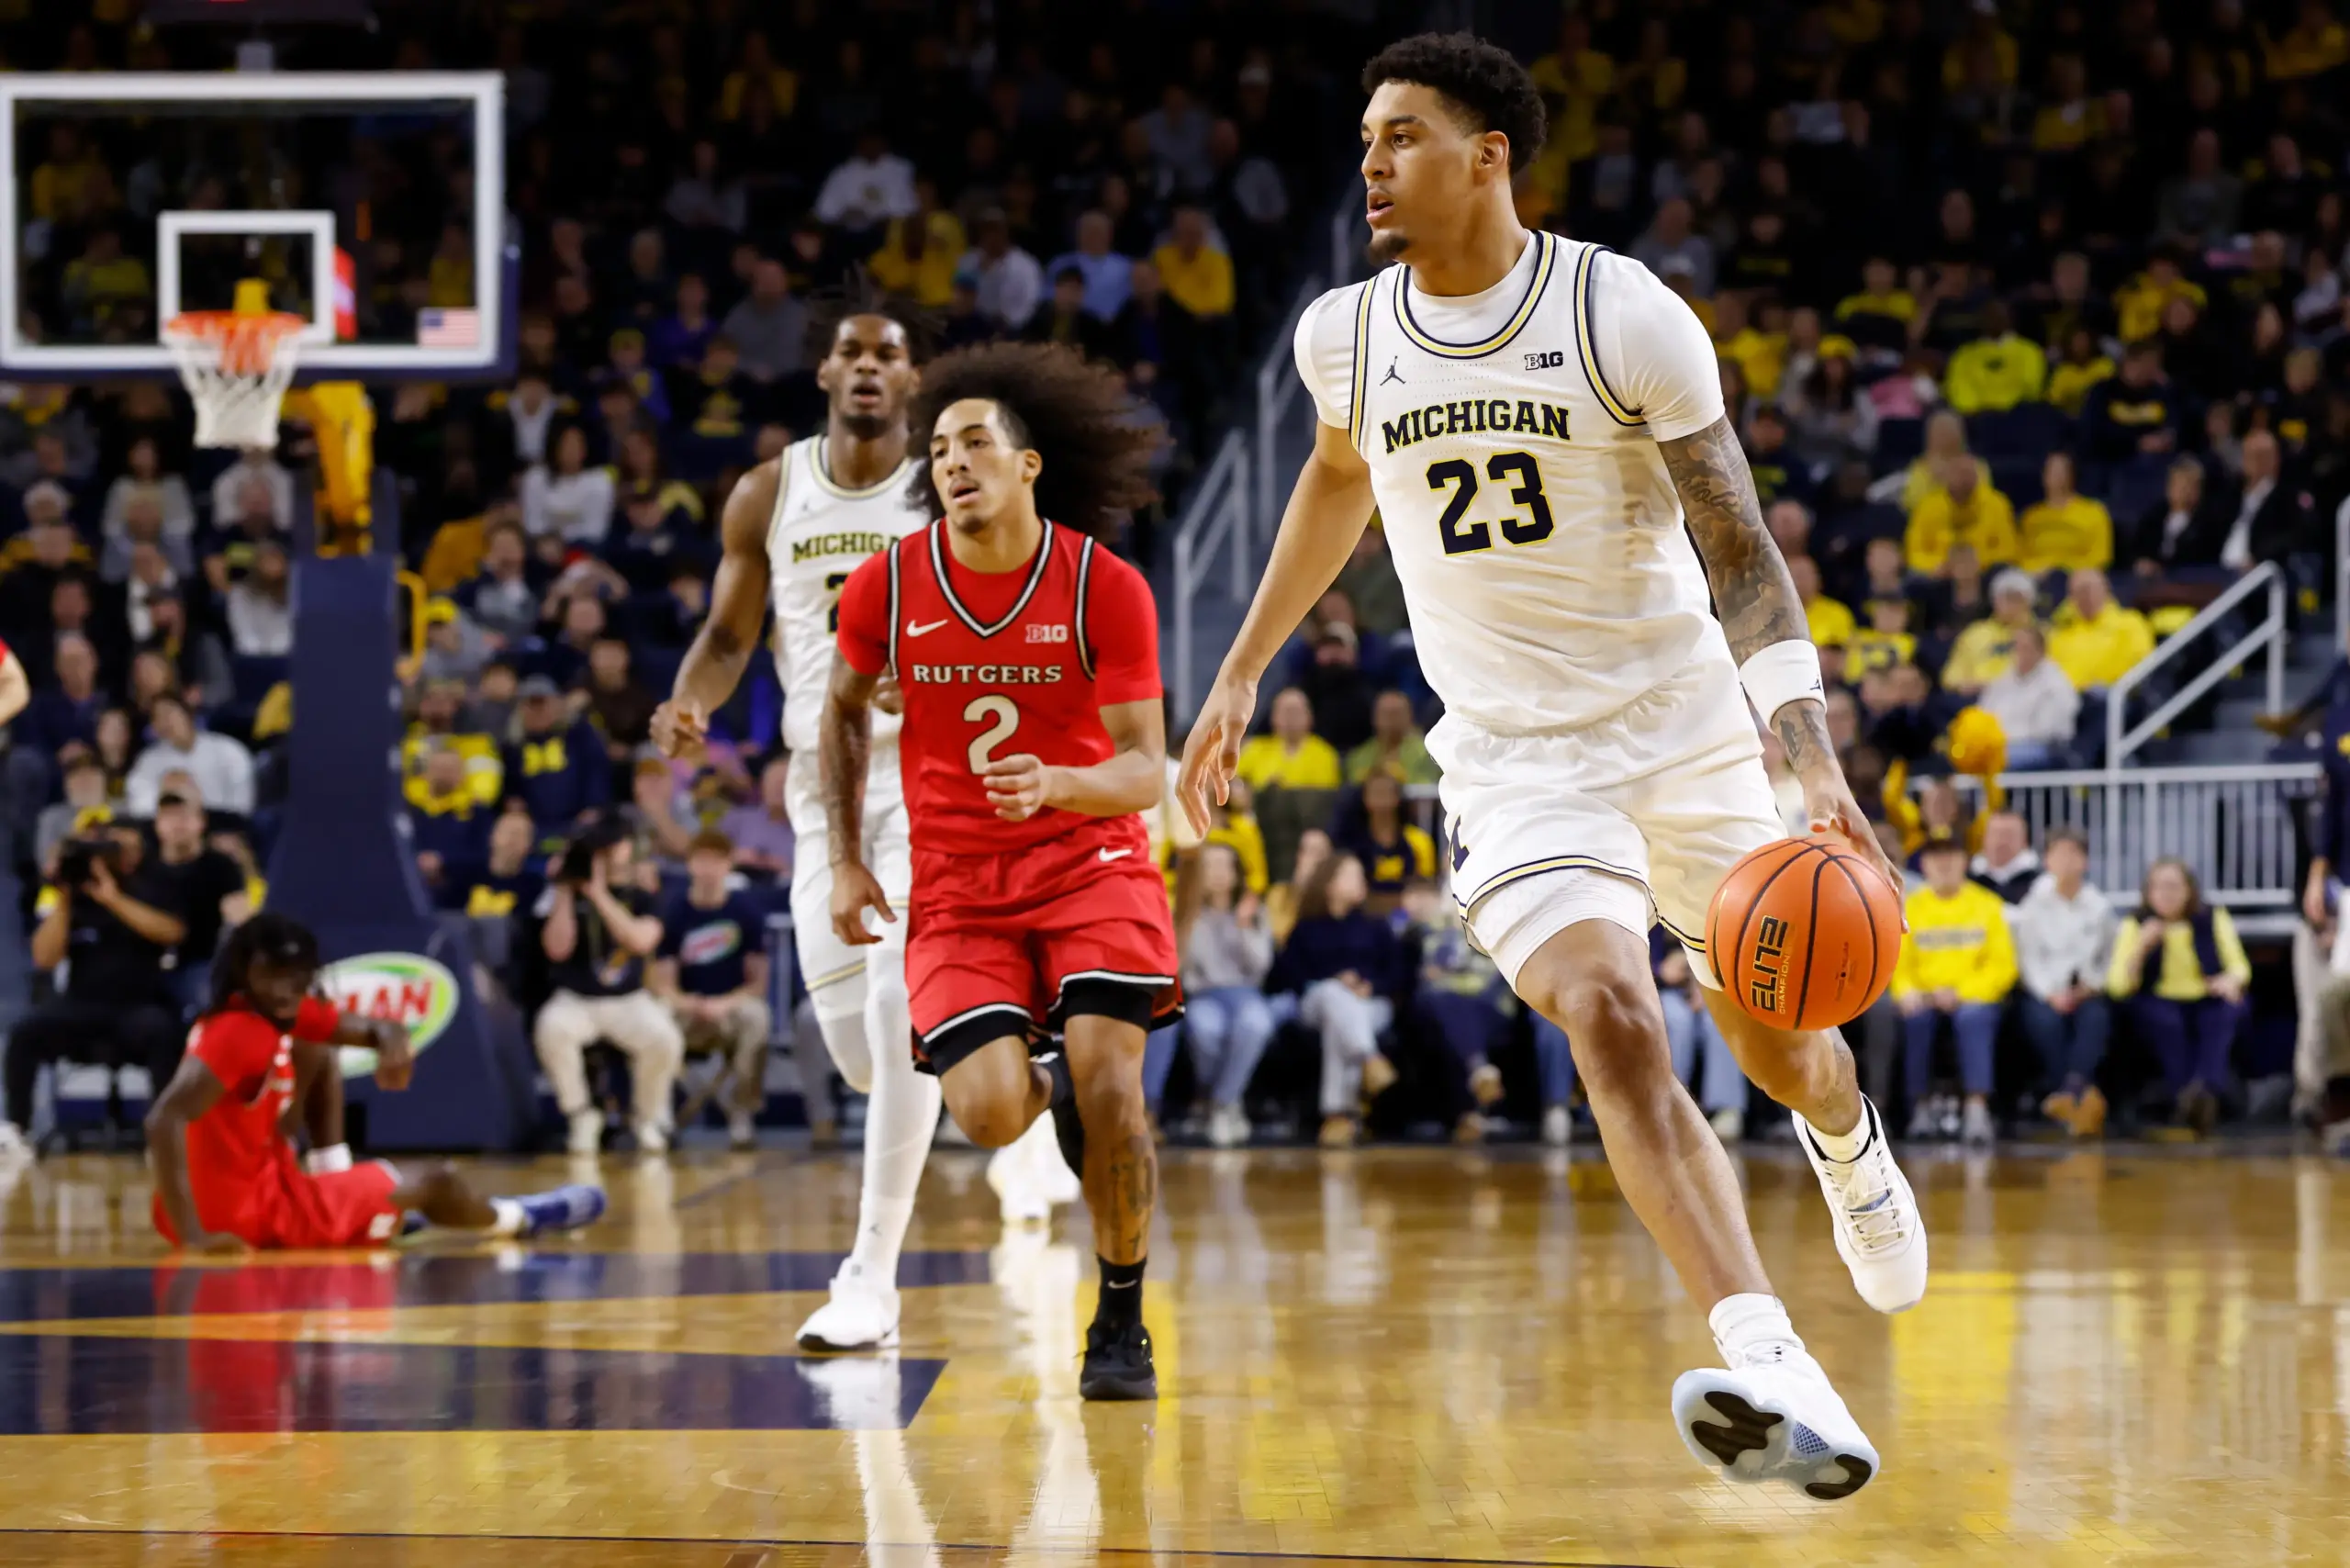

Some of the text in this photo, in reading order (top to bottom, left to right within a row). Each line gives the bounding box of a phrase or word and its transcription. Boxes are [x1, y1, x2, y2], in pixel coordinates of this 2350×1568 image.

[1382, 399, 1572, 454] MICHIGAN
[1426, 451, 1555, 556] 23
[912, 665, 1063, 684] RUTGERS
[964, 694, 1020, 776] 2
[1751, 914, 1789, 1012] ELITE
